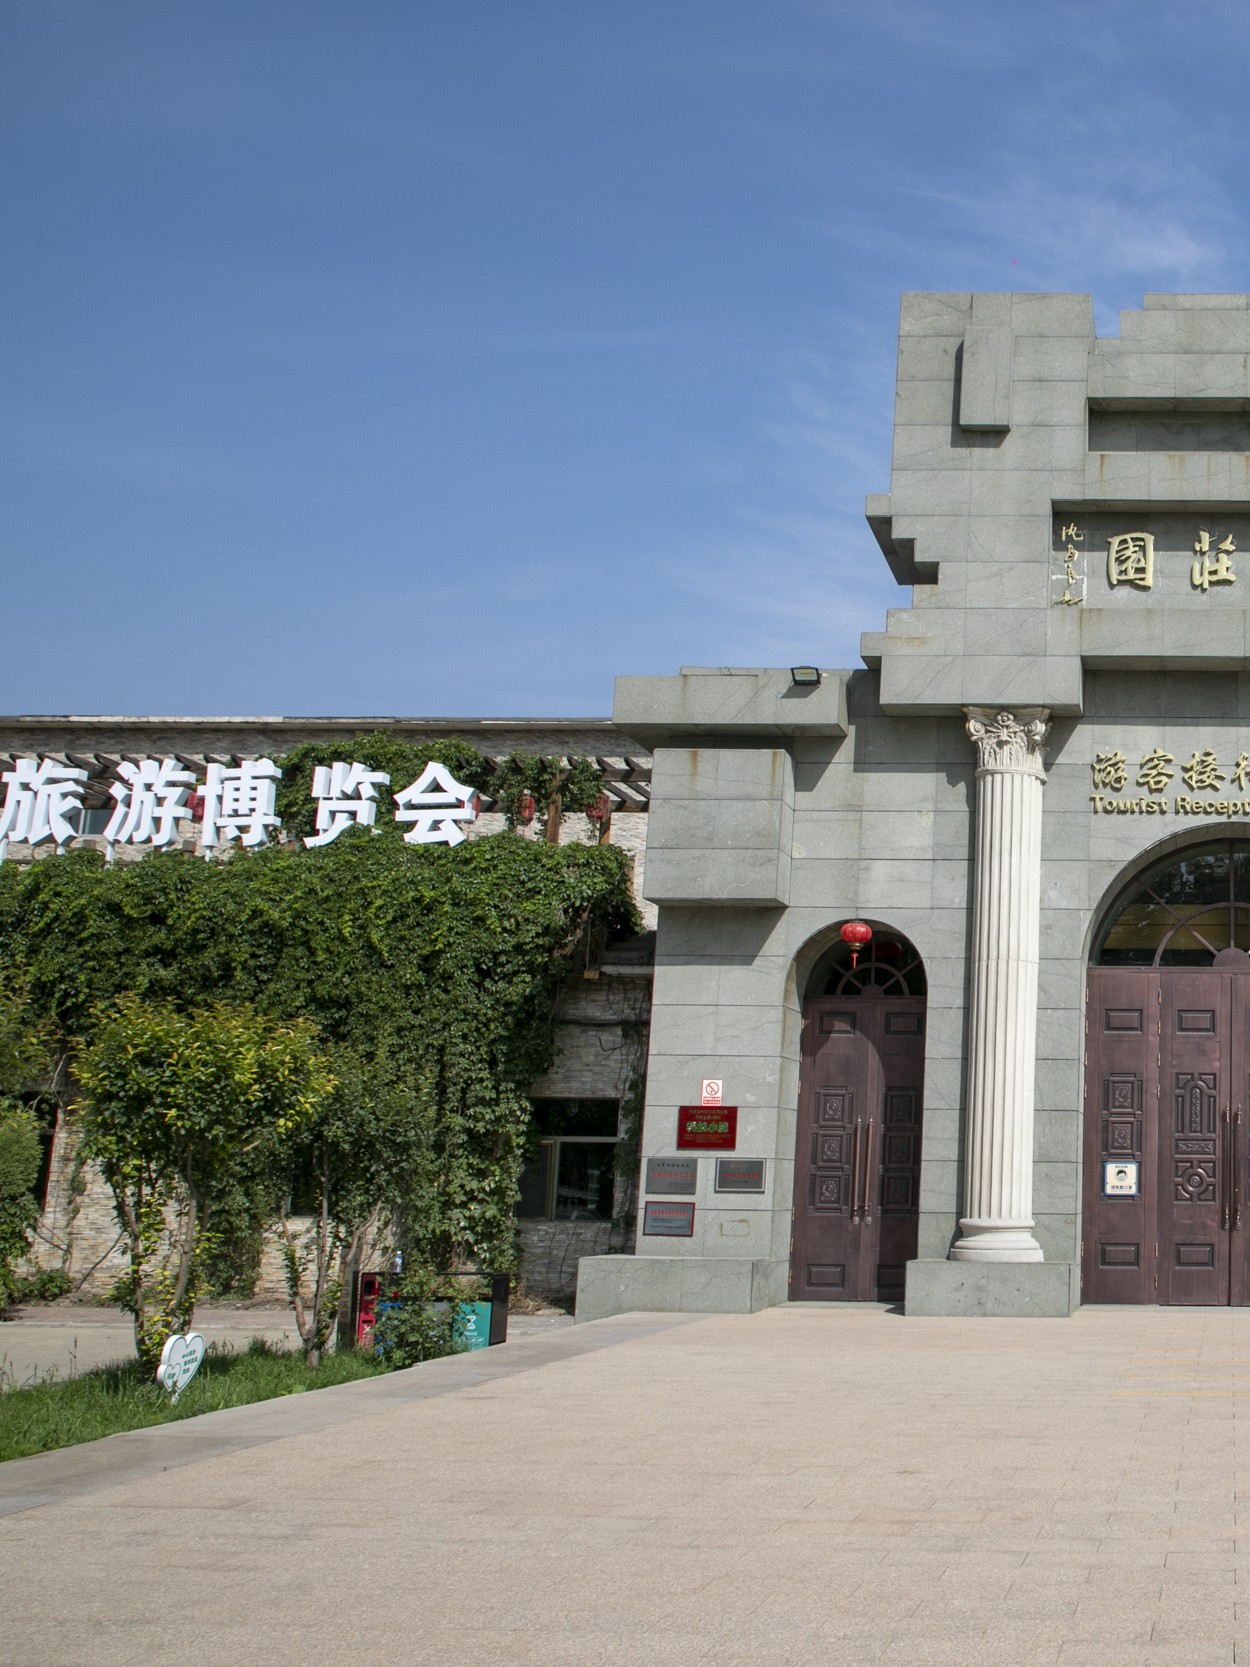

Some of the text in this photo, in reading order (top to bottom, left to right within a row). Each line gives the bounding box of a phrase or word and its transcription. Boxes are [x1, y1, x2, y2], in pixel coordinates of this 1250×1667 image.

[0, 757, 478, 848] 旅游博览会
[1091, 795, 1168, 816] Tourist
